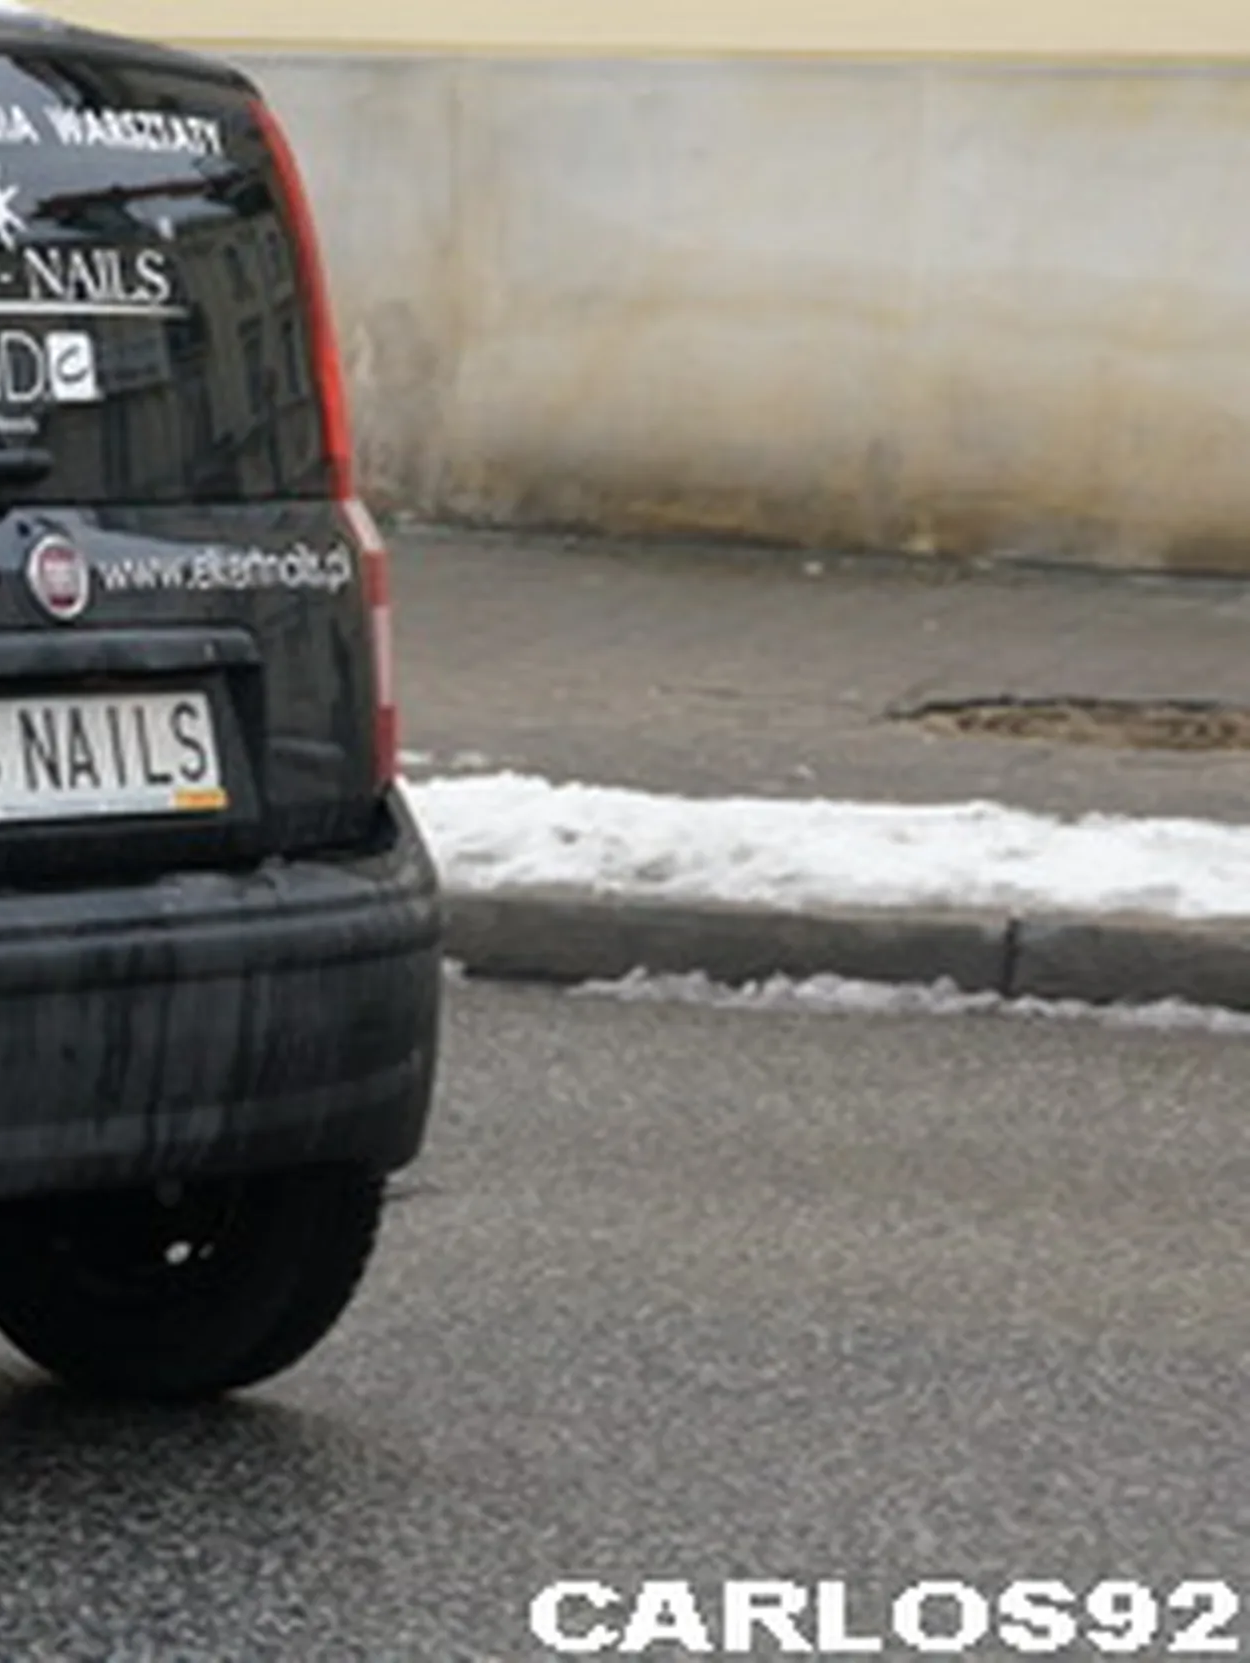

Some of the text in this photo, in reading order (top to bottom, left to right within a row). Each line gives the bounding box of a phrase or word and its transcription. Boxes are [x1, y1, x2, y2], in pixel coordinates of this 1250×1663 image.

[44, 104, 223, 156] WARSZTATY
[24, 250, 171, 302] NAILS
[17, 701, 209, 791] NAILS
